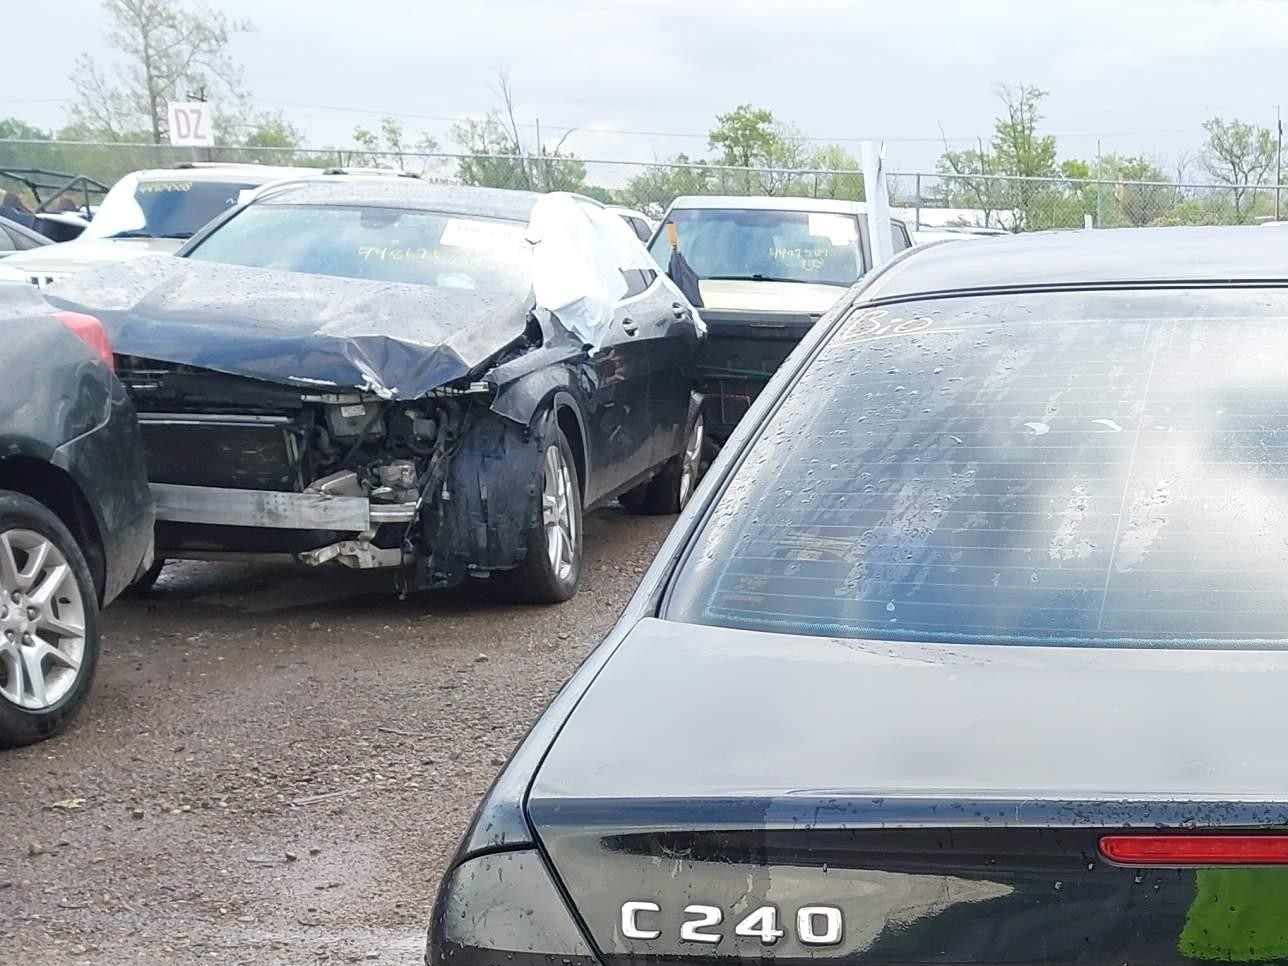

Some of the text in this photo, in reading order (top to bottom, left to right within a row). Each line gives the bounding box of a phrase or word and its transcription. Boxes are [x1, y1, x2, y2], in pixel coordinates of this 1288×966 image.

[174, 108, 207, 139] DZ
[620, 900, 845, 946] C 240
